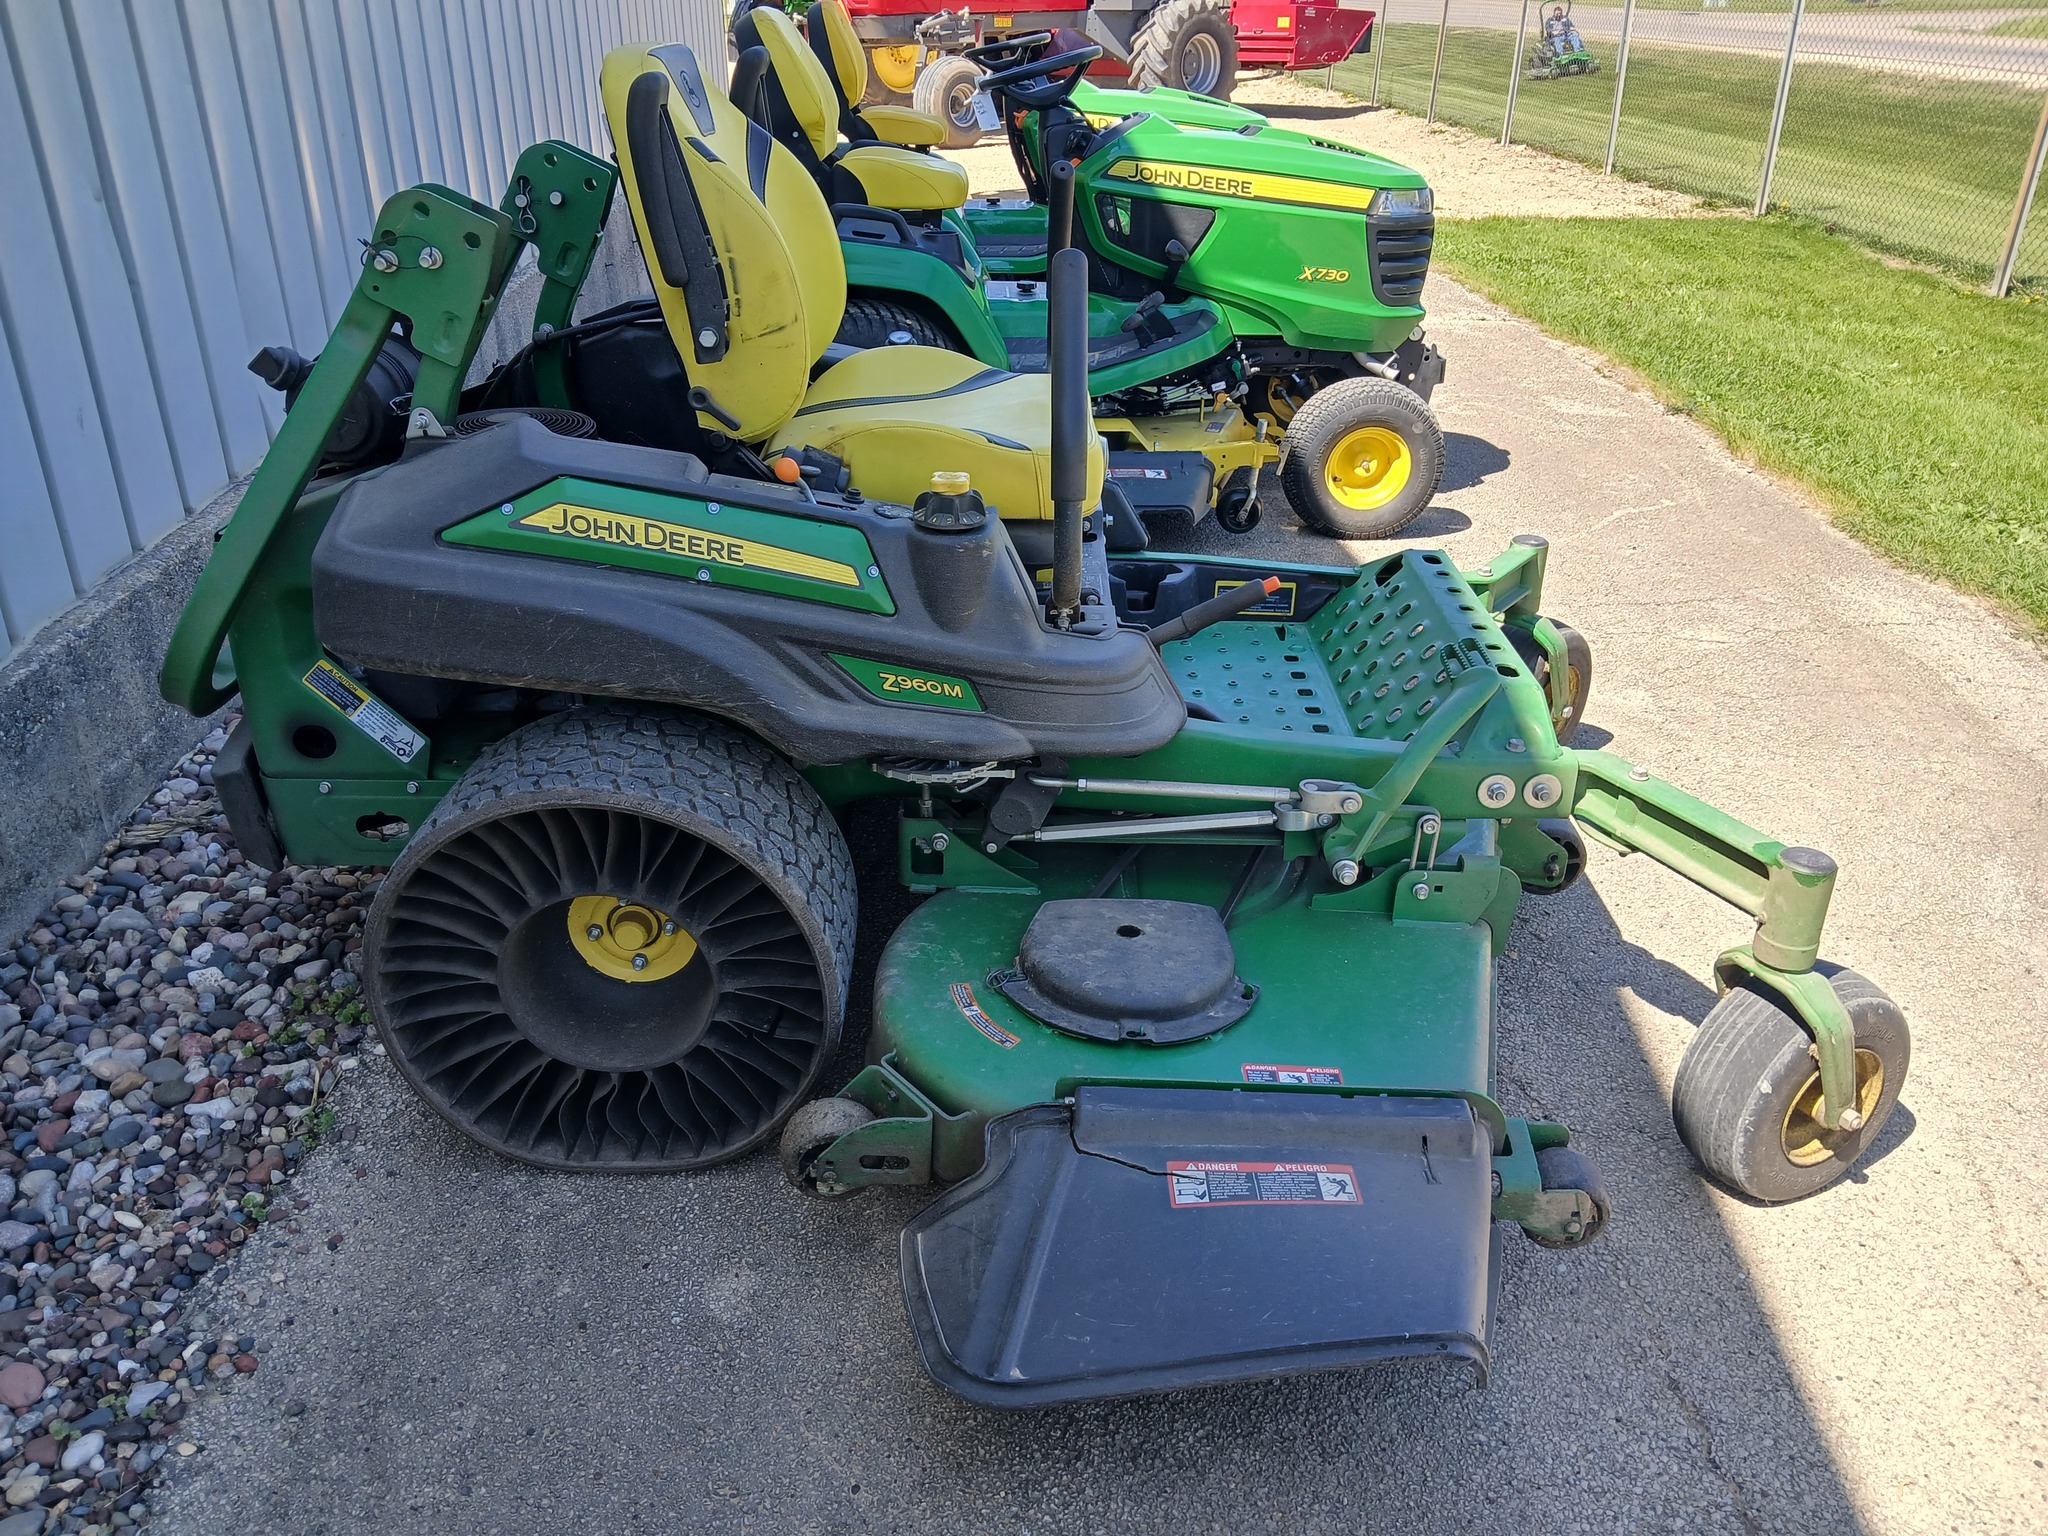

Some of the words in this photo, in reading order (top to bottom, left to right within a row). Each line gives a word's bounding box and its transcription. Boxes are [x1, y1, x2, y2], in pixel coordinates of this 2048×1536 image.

[1128, 163, 1182, 185] JOHN
[1187, 170, 1253, 195] DEERE
[1298, 266, 1350, 282] X730
[551, 508, 636, 544] JOHN
[644, 522, 744, 564] DEERE
[333, 671, 359, 693] CAUTION
[879, 672, 964, 698] Z960M
[1198, 1163, 1238, 1171] DANGER
[1285, 1164, 1328, 1172] PELIGRO
